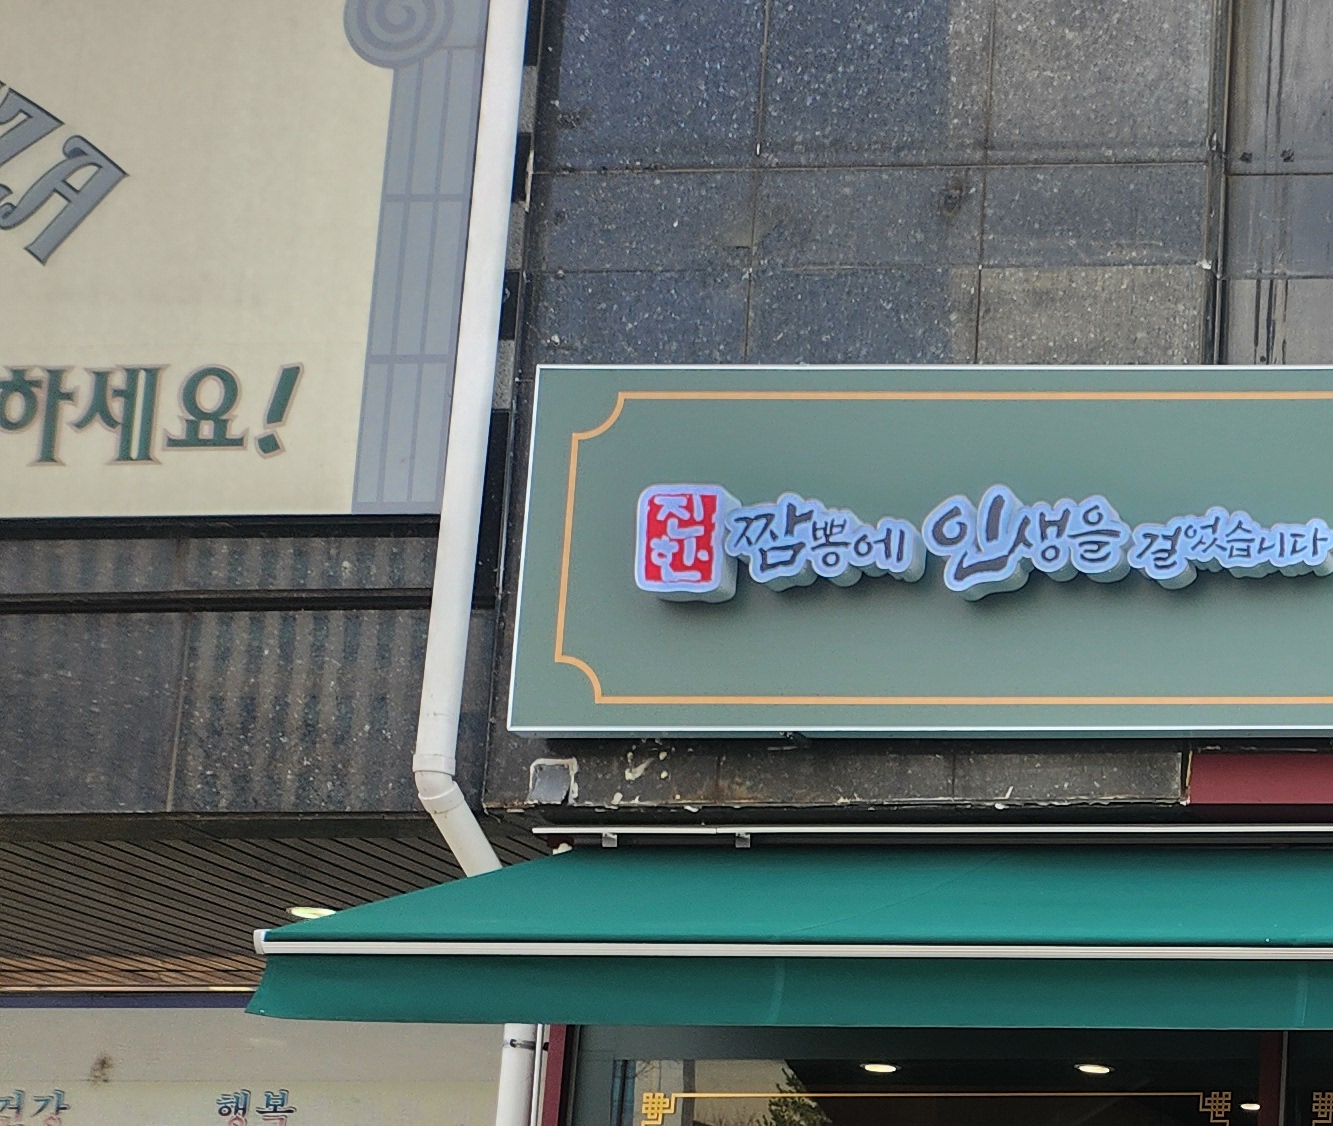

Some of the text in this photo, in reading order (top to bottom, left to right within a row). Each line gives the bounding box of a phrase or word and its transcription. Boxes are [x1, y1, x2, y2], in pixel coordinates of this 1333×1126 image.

[729, 503, 906, 573] 짬뽕에
[930, 494, 1127, 581] 인생을
[1135, 522, 1329, 571] 걸었습니다
